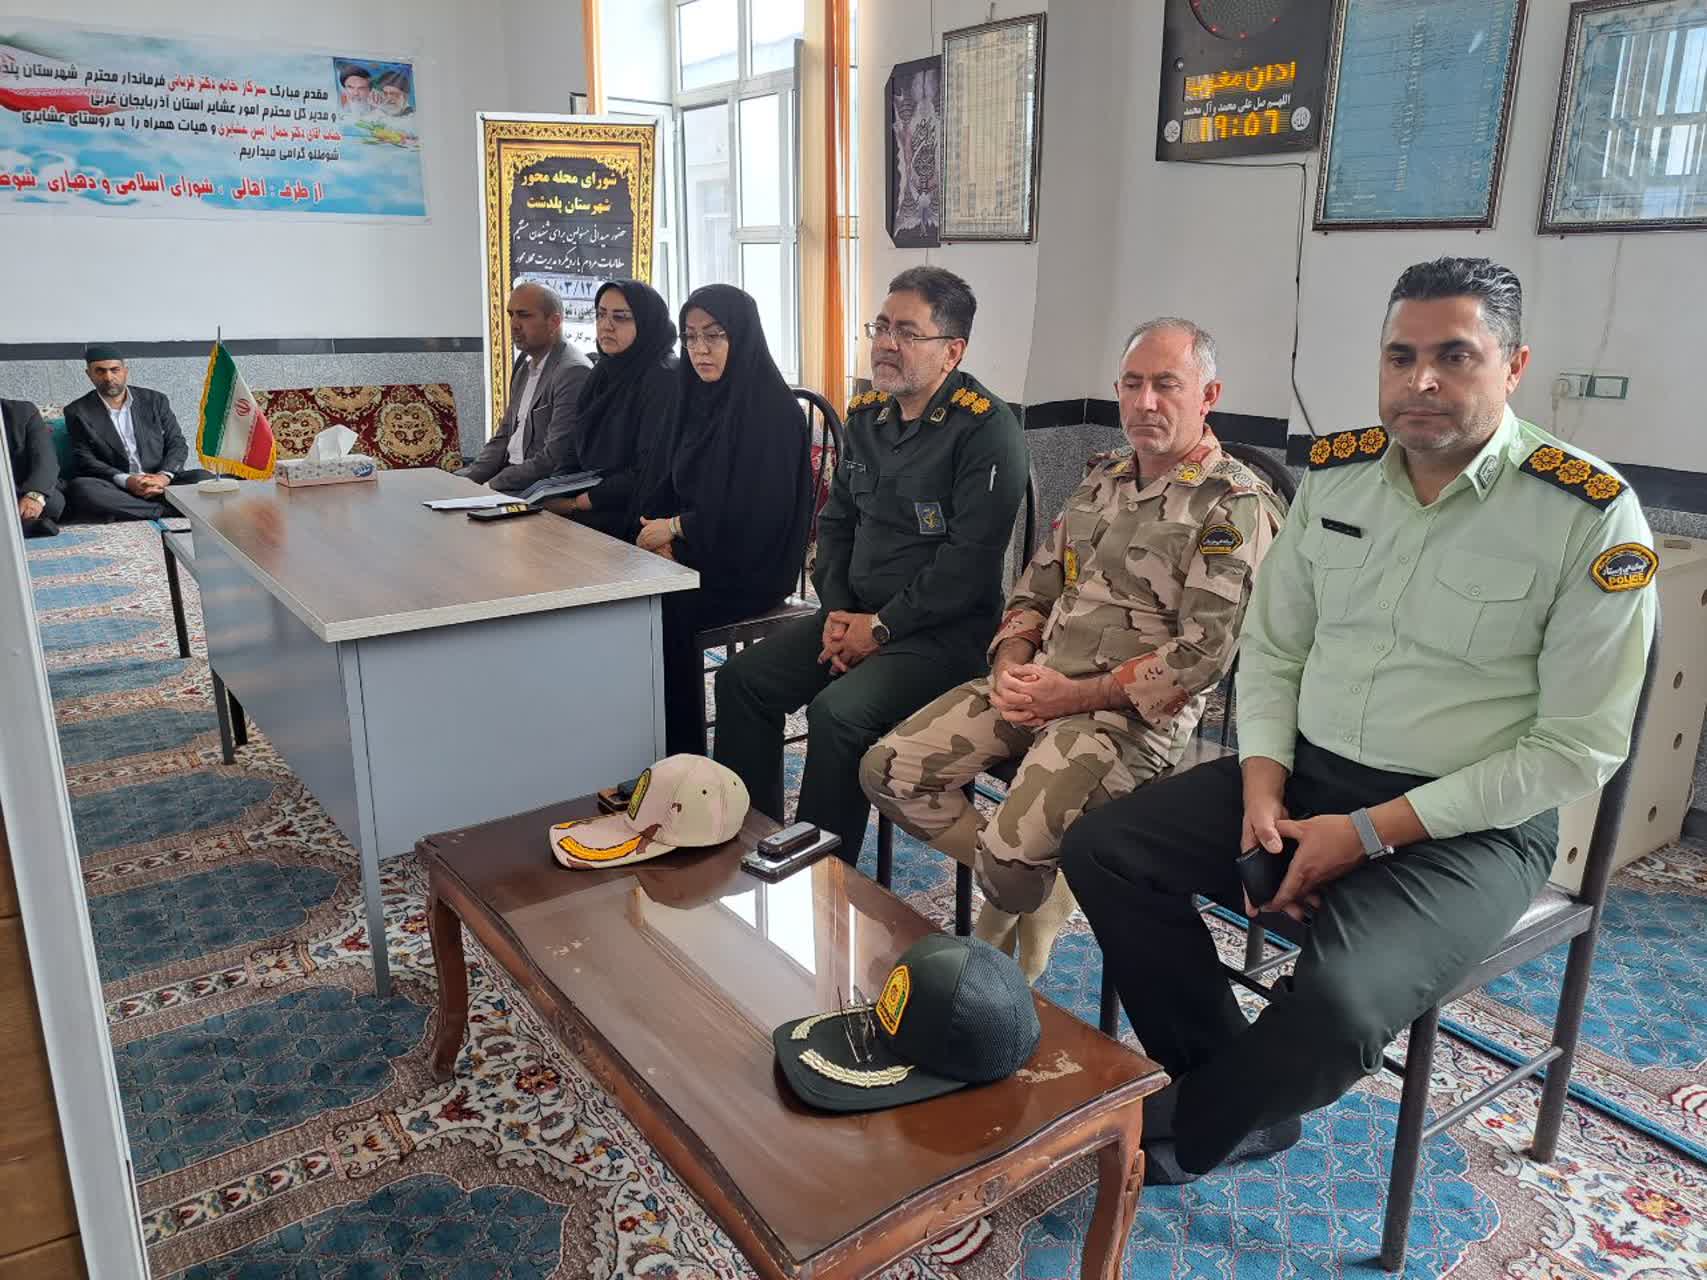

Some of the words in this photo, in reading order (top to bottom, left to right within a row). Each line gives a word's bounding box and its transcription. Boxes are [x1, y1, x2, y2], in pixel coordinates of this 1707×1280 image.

[0, 62, 19, 80] پلد
[23, 63, 78, 80] شهرستان
[85, 68, 118, 86] محترم
[122, 71, 165, 88] فرماندار
[91, 92, 116, 106] غربی
[119, 92, 169, 109] آذربایجان
[270, 84, 300, 100] مبارک
[303, 87, 328, 104] مقدم
[173, 97, 203, 112] استان
[207, 98, 235, 115] عشایر
[239, 103, 259, 116] امور
[1184, 104, 1201, 115] محمد
[1218, 102, 1236, 112] محمد
[1254, 97, 1266, 110] صل
[1267, 94, 1291, 109] اللهم
[22, 106, 65, 125] عشایری
[69, 111, 110, 128] روستای
[262, 104, 291, 121] محترم
[294, 107, 306, 121] کل
[308, 110, 329, 123] مدیر
[114, 117, 125, 128] به
[131, 115, 140, 129] را
[143, 117, 175, 131] همراه
[178, 118, 208, 135] هیات
[211, 124, 217, 135] و
[239, 144, 276, 160] میداریم
[48, 169, 96, 192] دهیاری
[116, 172, 165, 195] اسلامی
[521, 172, 550, 187] محور
[552, 170, 578, 184] محله
[581, 171, 617, 190] شورای
[102, 178, 110, 194] و
[170, 175, 213, 197] شورای
[233, 176, 265, 200] اهالی
[280, 179, 309, 200] طرف
[314, 182, 323, 202] از
[527, 195, 562, 213] پلدشت
[565, 197, 612, 215] شهرستان
[528, 220, 550, 245] شنیدن
[548, 229, 566, 243] برای
